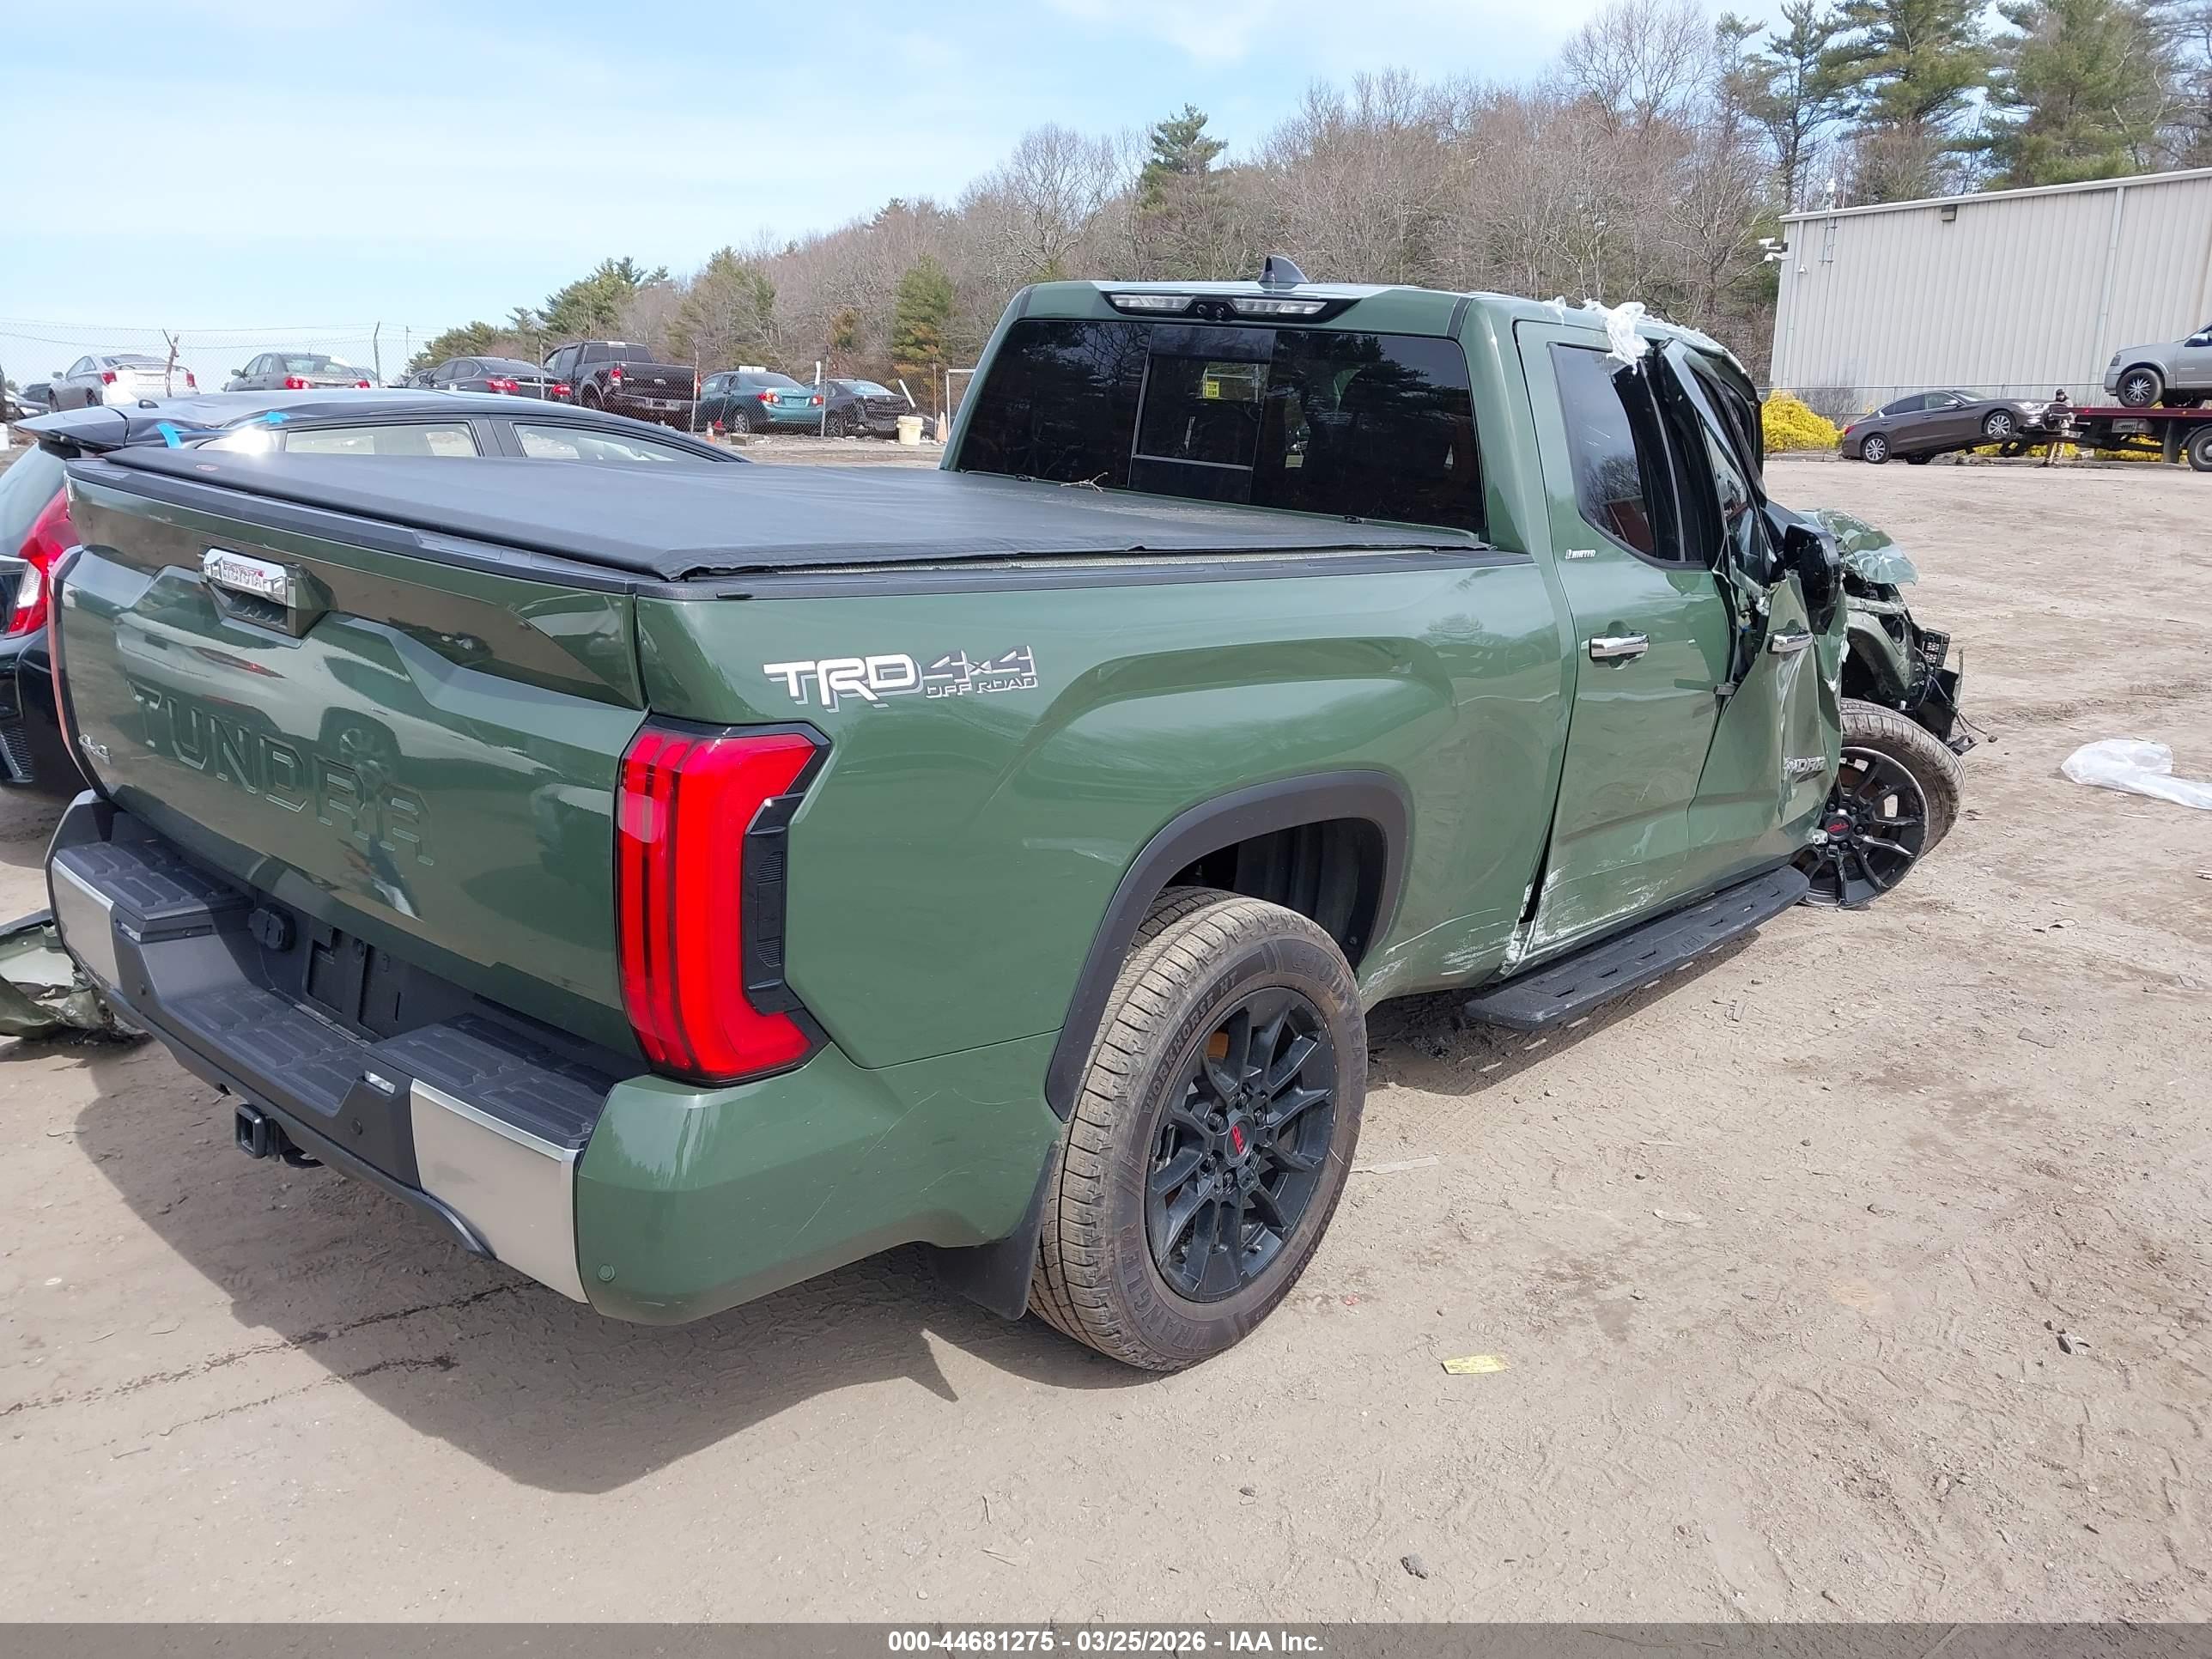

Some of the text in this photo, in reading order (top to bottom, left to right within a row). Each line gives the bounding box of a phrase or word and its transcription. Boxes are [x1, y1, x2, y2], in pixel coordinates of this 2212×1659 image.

[223, 564, 263, 590] TOYOTA
[763, 653, 922, 712] TRD
[926, 677, 1038, 699] OFF ROAD
[126, 678, 434, 866] TUNDRA
[1143, 970, 1237, 1114] WORKHORSE HT
